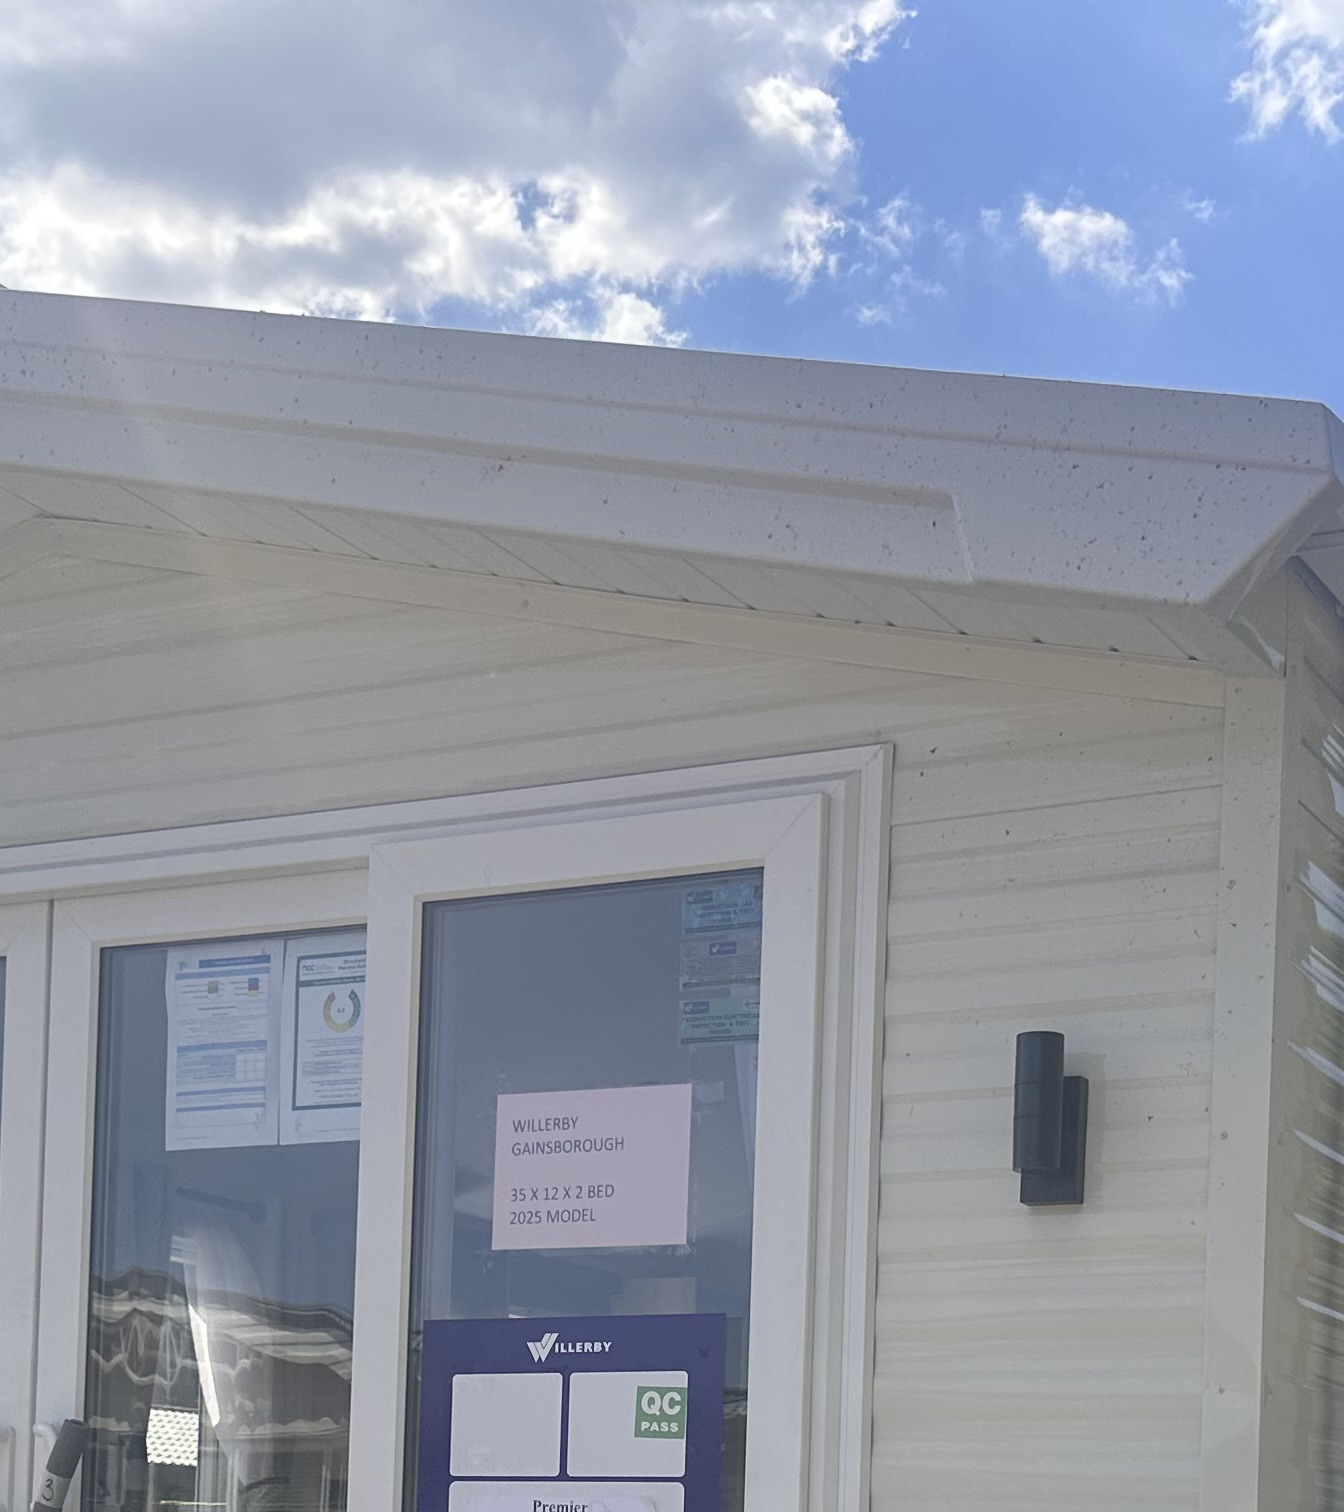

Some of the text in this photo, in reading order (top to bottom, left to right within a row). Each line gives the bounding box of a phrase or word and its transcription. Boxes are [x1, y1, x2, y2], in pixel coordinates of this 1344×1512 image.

[512, 1116, 579, 1133] WILLERBY
[511, 1137, 625, 1156] GAINSBOROUGH
[511, 1184, 615, 1202] 35 X 12 X 2 BED
[509, 1208, 597, 1225] 2025 MODEL
[527, 1332, 613, 1363] WILLERBY
[641, 1390, 682, 1416] QC
[640, 1421, 679, 1433] PASS
